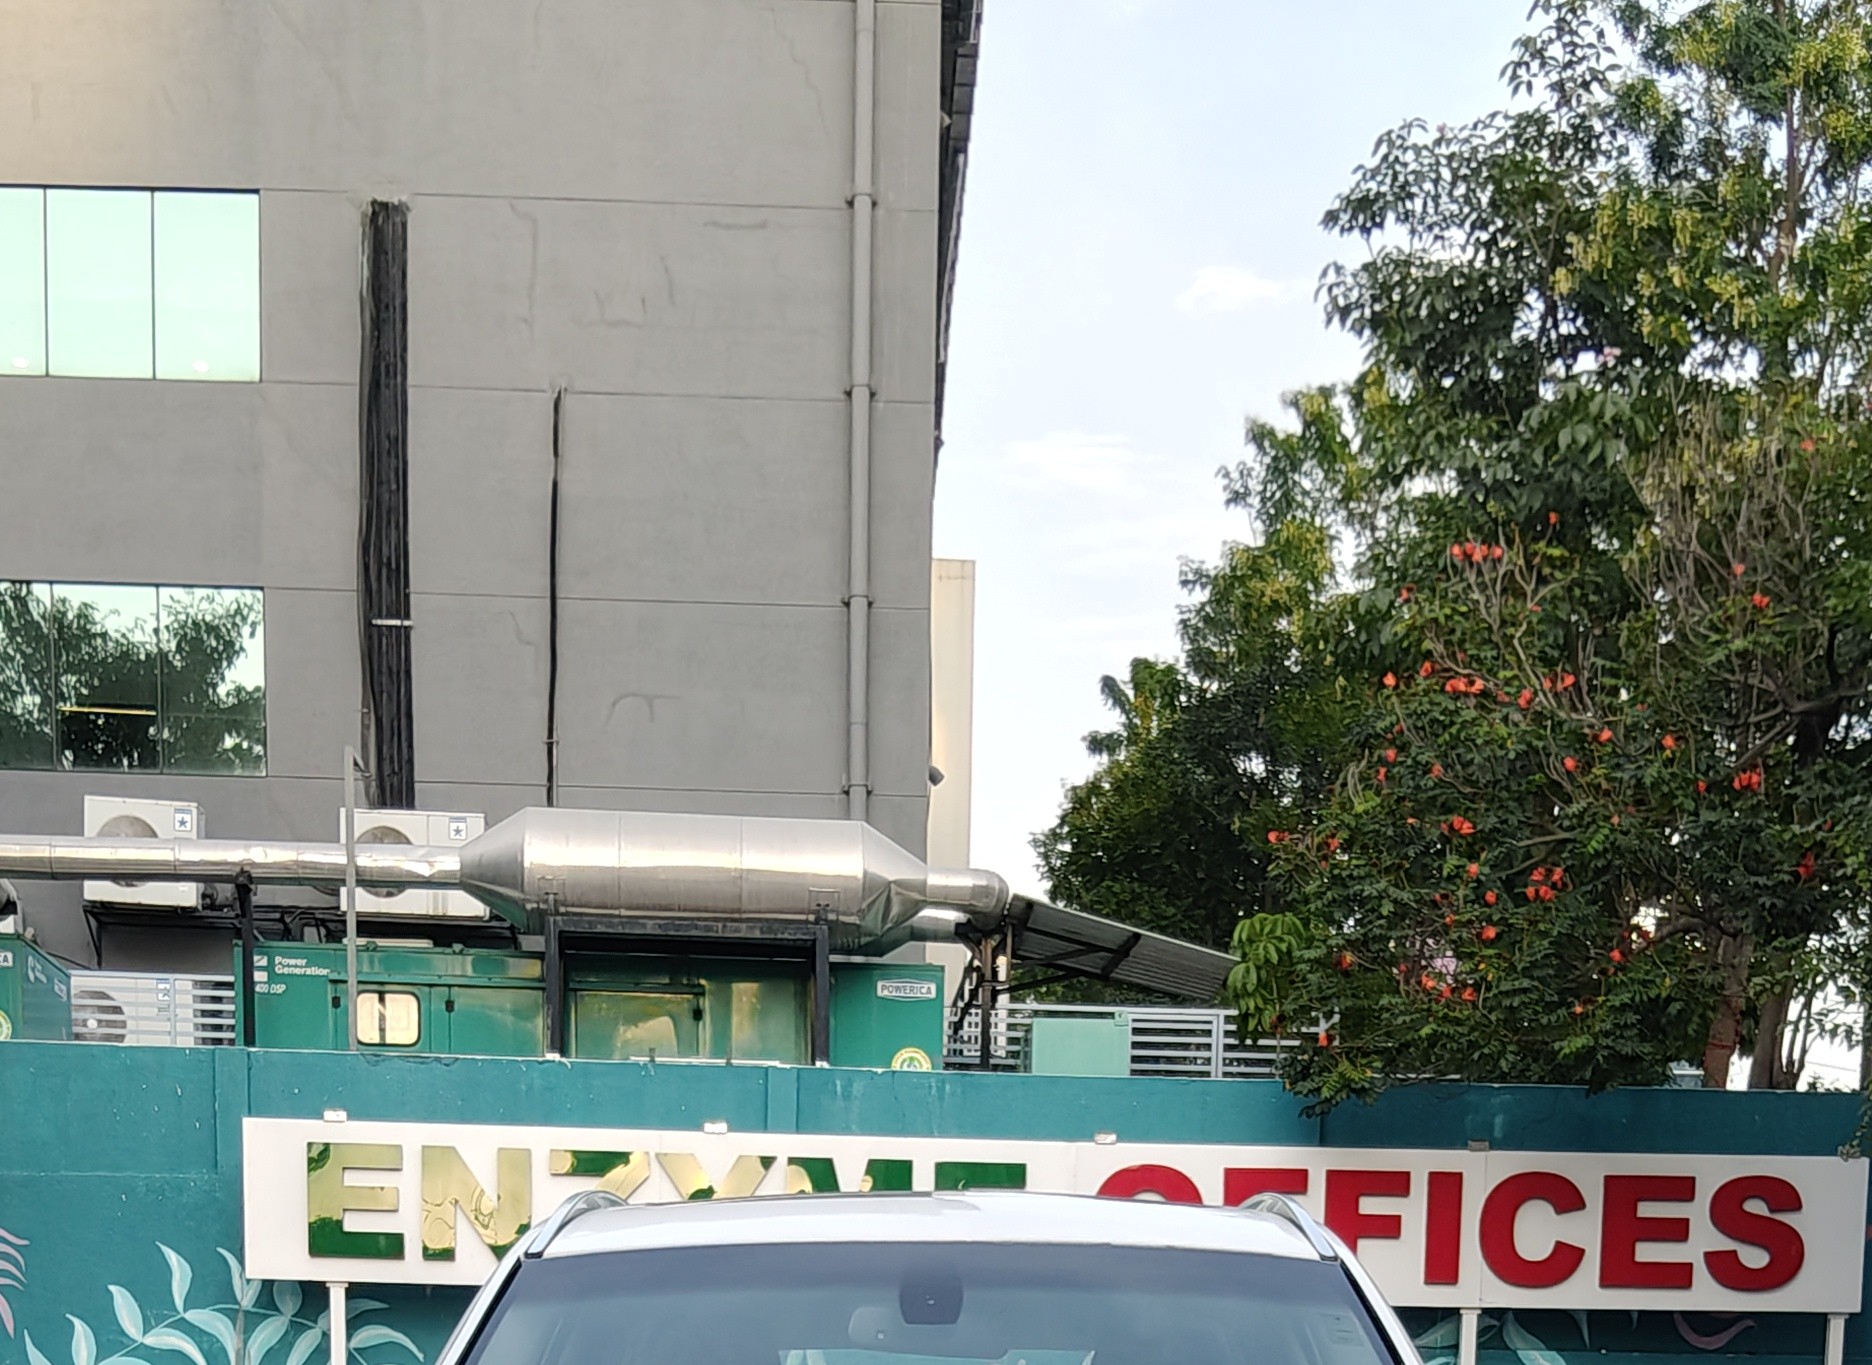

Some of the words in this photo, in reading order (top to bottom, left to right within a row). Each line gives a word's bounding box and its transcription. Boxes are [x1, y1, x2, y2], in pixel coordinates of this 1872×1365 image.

[274, 956, 308, 966] Power
[274, 965, 331, 976] Generation
[880, 984, 933, 995] POWERICA
[306, 1141, 1028, 1263] ENZY
[1096, 1163, 1806, 1292] FICES
